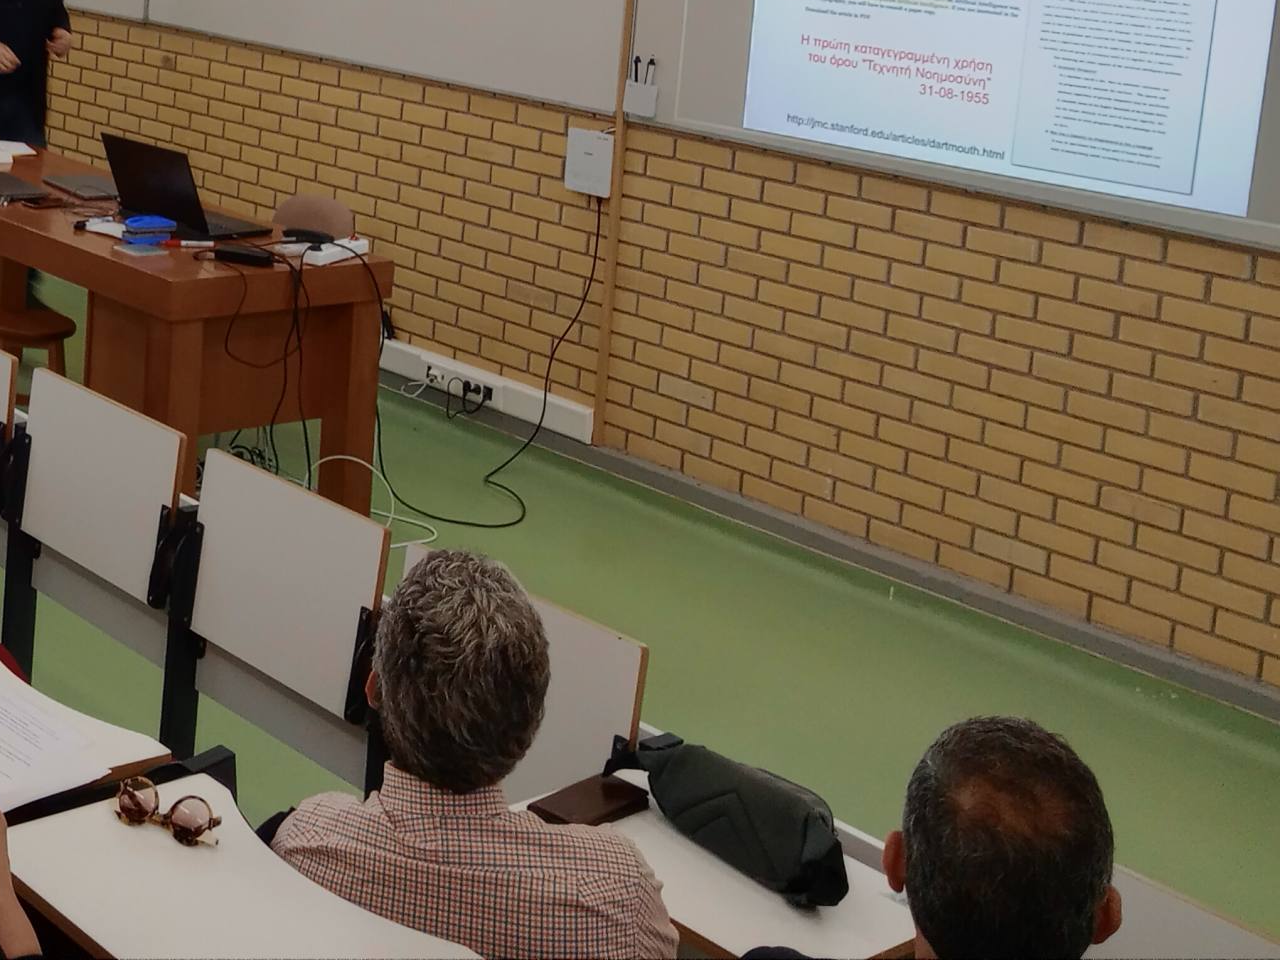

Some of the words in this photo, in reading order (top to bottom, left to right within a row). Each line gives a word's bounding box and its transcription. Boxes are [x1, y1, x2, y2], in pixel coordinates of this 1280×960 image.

[808, 53, 827, 65] του
[829, 54, 858, 71] όρου
[813, 37, 851, 55] πρώτη
[854, 44, 951, 70] καταγεγραμμένη
[953, 56, 993, 74] χρήση
[919, 84, 990, 105] 31-08-1955
[786, 113, 1005, 161] http://jmc.stanford.edu/articles/dartmouth.html
